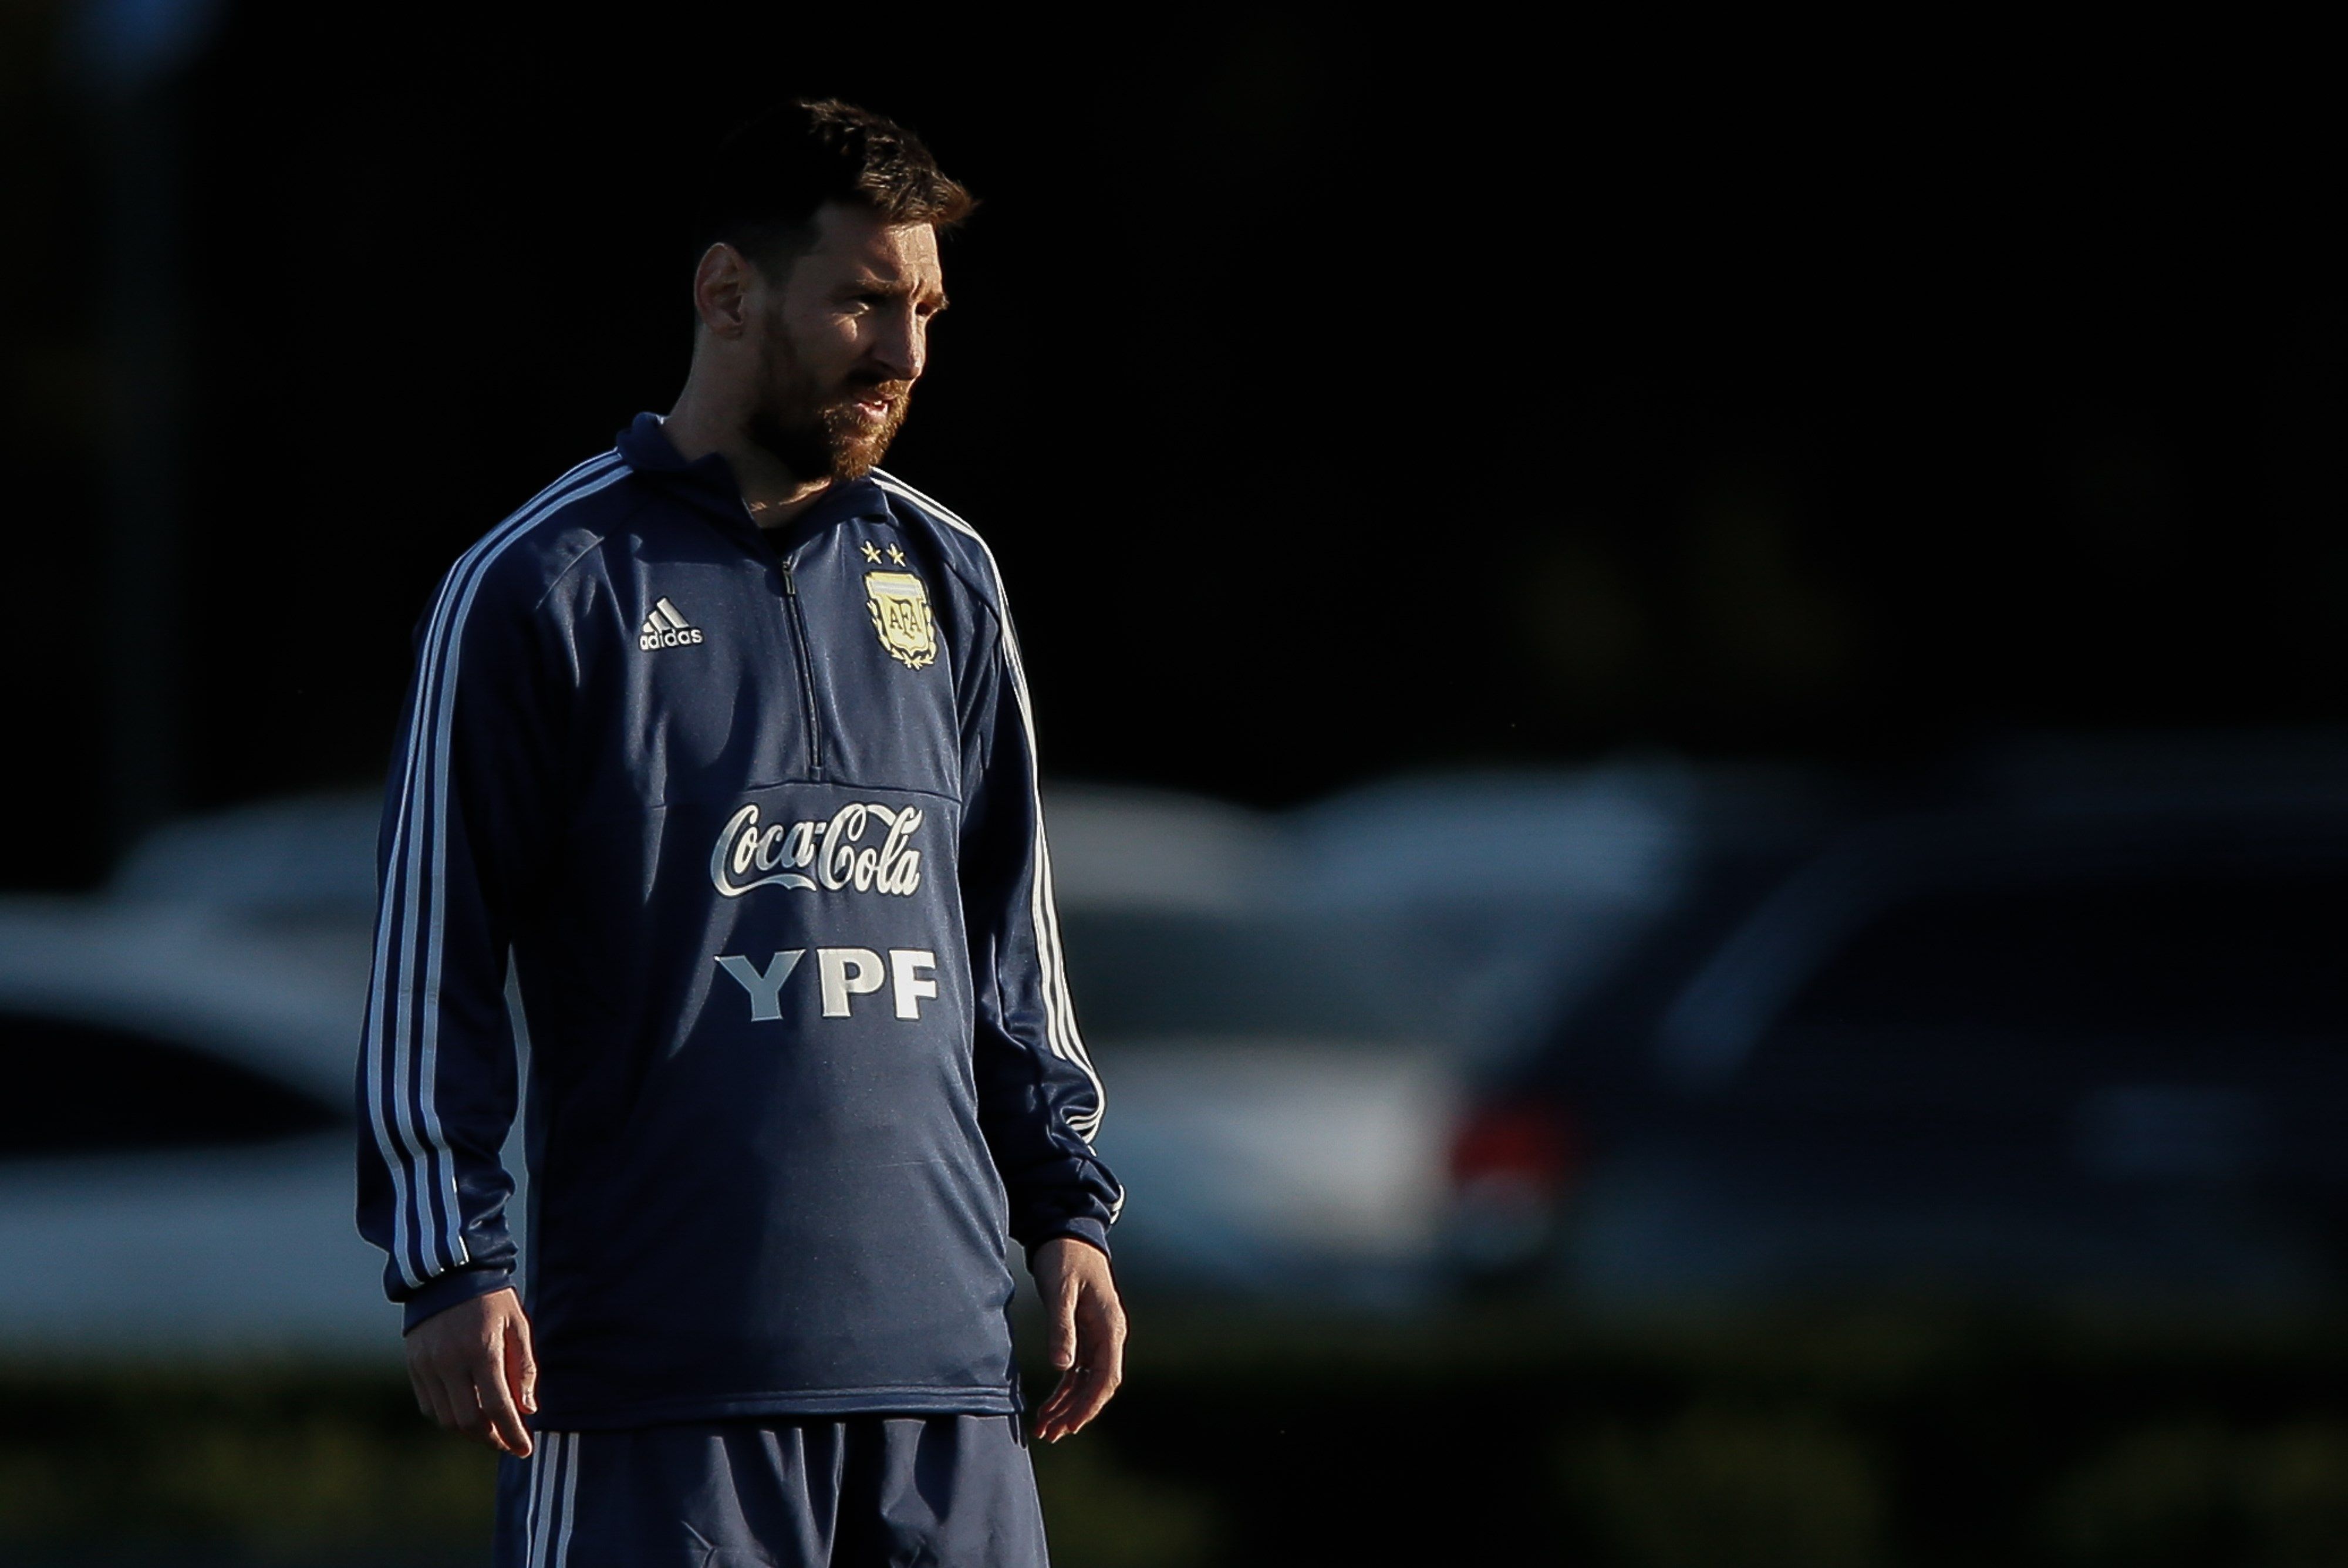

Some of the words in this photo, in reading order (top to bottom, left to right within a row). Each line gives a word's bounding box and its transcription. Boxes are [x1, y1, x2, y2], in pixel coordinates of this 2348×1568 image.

[639, 628, 703, 650] adidas
[888, 597, 922, 640] AFA
[710, 802, 923, 897] Coca-Cola
[713, 948, 937, 1021] YPF
